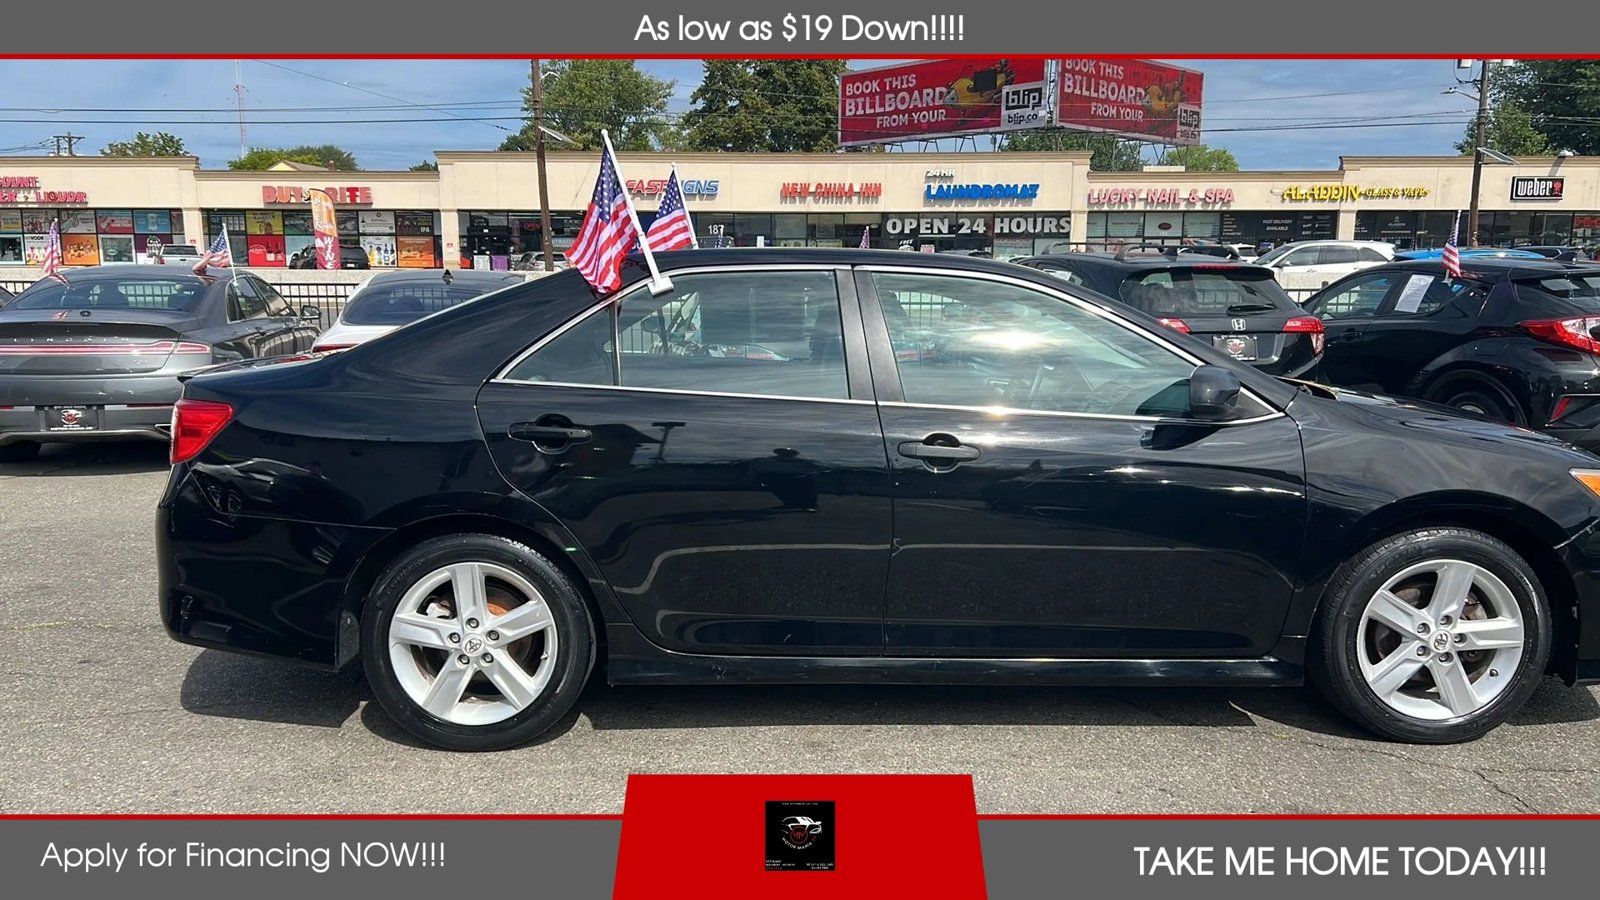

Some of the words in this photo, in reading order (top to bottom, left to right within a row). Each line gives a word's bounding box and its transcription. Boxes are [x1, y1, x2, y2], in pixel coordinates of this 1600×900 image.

[1066, 59, 1096, 74] BOOK
[1100, 62, 1124, 79] THIS
[846, 79, 880, 96] BOOK
[884, 74, 917, 91] THIS
[1064, 73, 1145, 106] BILLBOARD
[845, 87, 949, 117] BILLBOARD
[1006, 87, 1042, 110] blip
[876, 114, 909, 128] FROM
[912, 110, 946, 125] YOUR
[1091, 102, 1117, 118] FROM
[1119, 107, 1144, 122] YOUR
[262, 185, 303, 204] BUY
[782, 182, 810, 197] NEW
[815, 182, 855, 197] CHINA
[860, 182, 882, 197] INN
[926, 183, 1039, 199] LAUNDROMAT
[1089, 188, 1143, 204] LUCKY
[1147, 188, 1181, 204] NAIL
[1188, 188, 1200, 204] &
[1205, 188, 1235, 203] SPA
[1283, 184, 1360, 201] ALADDIN
[1517, 177, 1553, 197] weber
[36, 190, 87, 203] LIQUOR
[708, 224, 724, 236] 187
[886, 217, 949, 235] OPEN
[957, 217, 986, 235] 24
[994, 217, 1071, 235] HOURS
